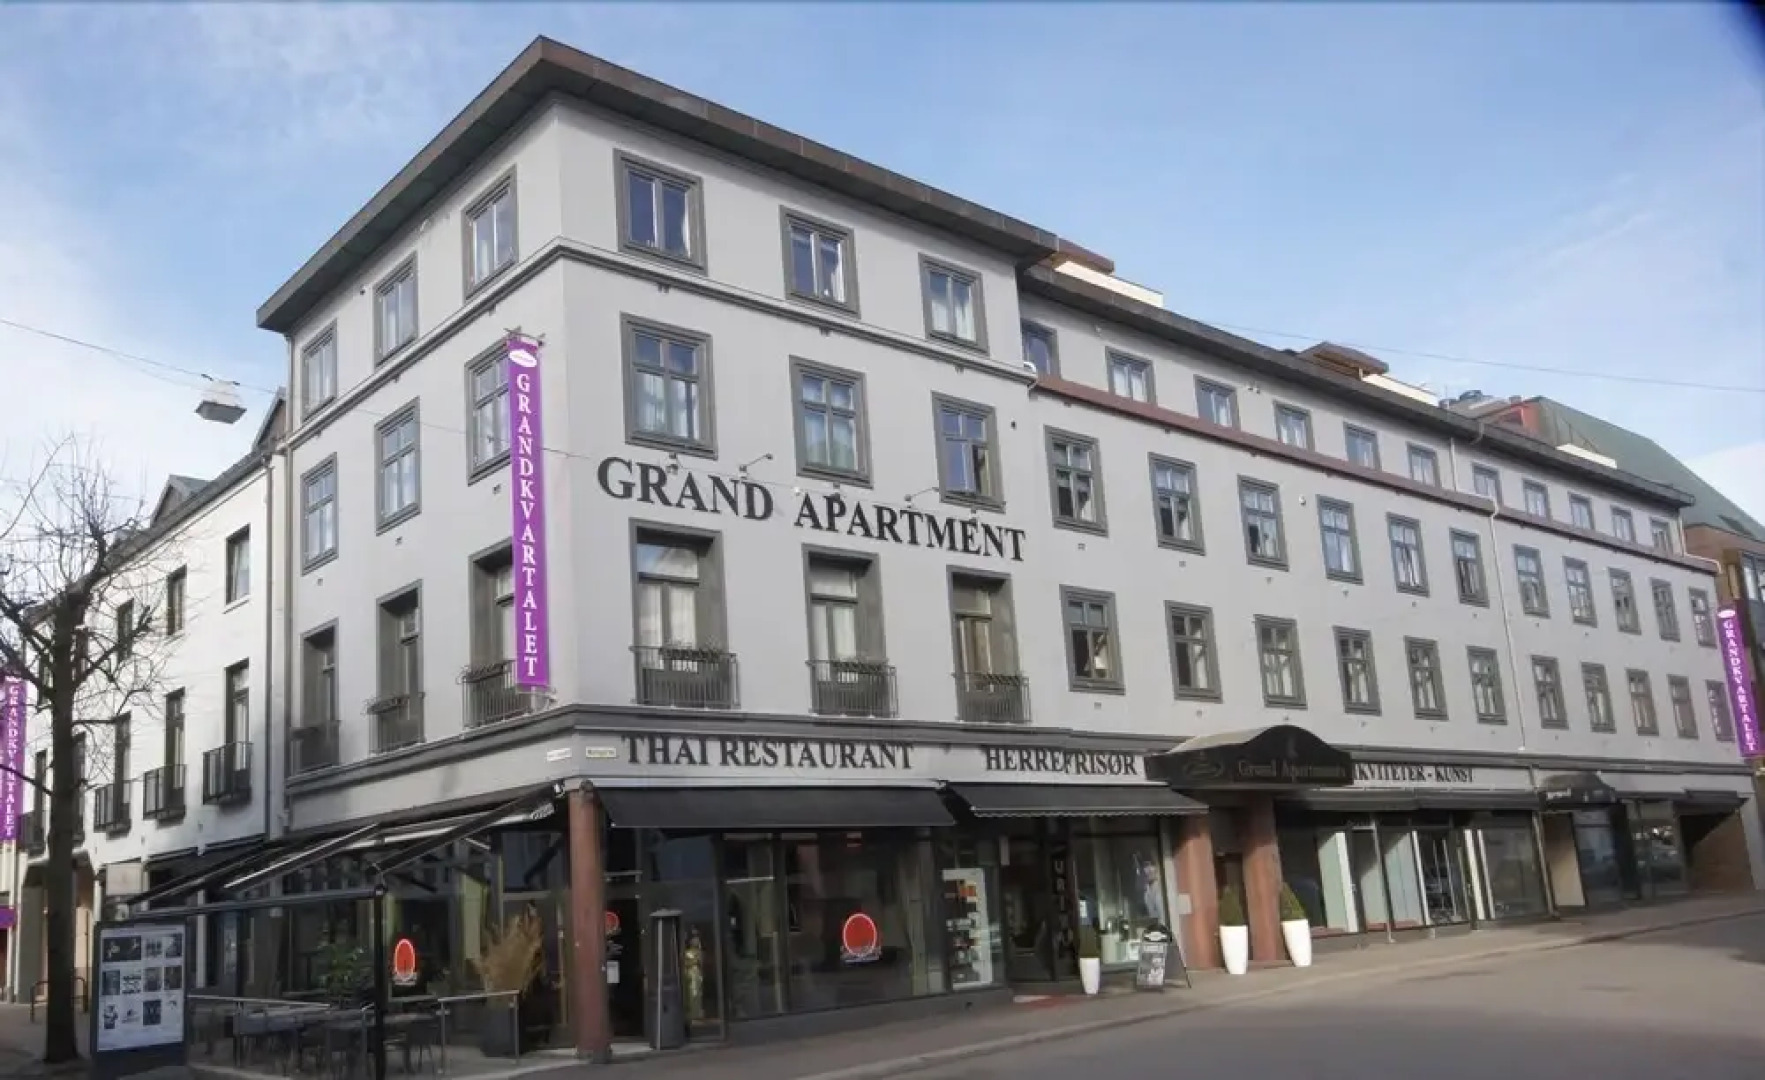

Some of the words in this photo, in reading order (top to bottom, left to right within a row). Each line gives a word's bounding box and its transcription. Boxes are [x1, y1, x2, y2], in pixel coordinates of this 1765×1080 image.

[515, 373, 538, 677] GRANDKVARTALET
[597, 456, 774, 521] GRAND
[794, 493, 1026, 561] APARTMENT
[1722, 618, 1756, 751] GRANDKVARTALET
[621, 734, 711, 766] THAI
[718, 737, 914, 769] RESTAURANT
